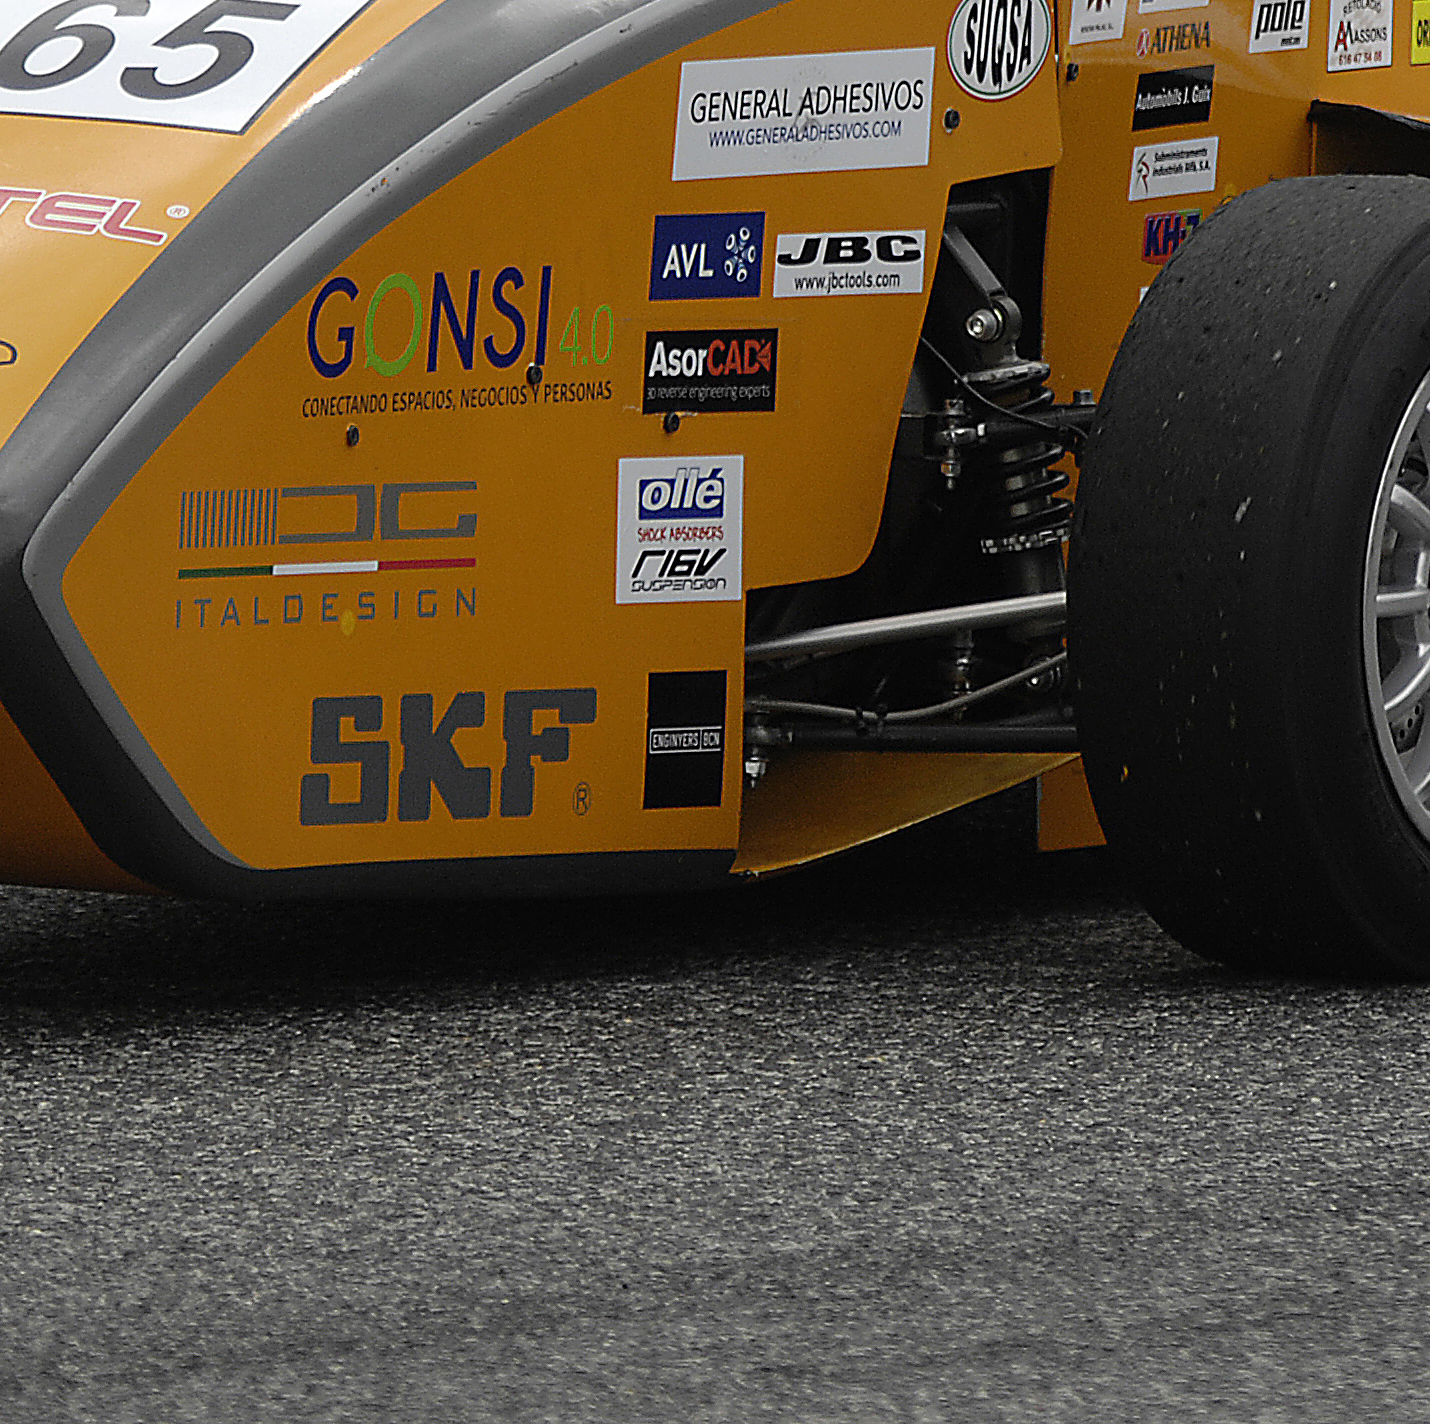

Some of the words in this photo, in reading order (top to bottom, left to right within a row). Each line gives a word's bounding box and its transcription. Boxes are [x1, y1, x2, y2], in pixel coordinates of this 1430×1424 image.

[1151, 21, 1210, 54] ATHENA
[690, 87, 792, 123] GENERAL
[798, 79, 924, 116] ADHESIVOS
[709, 121, 902, 147] WWW.GENERALADHESIVOS.COM
[662, 243, 714, 278] AVL
[777, 235, 922, 266] JBC
[794, 271, 900, 294] www.jbctools.com
[307, 265, 553, 379] GONSI
[559, 304, 614, 367] 4.0
[649, 339, 761, 377] AsorCAD
[302, 393, 387, 418] CONECTANDO
[392, 389, 455, 413] ESPACIOS,
[460, 384, 528, 408] NEGOCIOS
[531, 384, 541, 405] Y
[543, 380, 613, 404] PERSONAS
[689, 384, 738, 402] engineering
[739, 384, 770, 400] experts
[642, 467, 723, 511] ollé
[638, 527, 667, 543] SHOCK
[669, 525, 724, 543] ABSORBERS
[631, 578, 727, 592] SUSPENSION
[176, 587, 476, 629] ITALDESIGN
[300, 688, 598, 827] SKF
